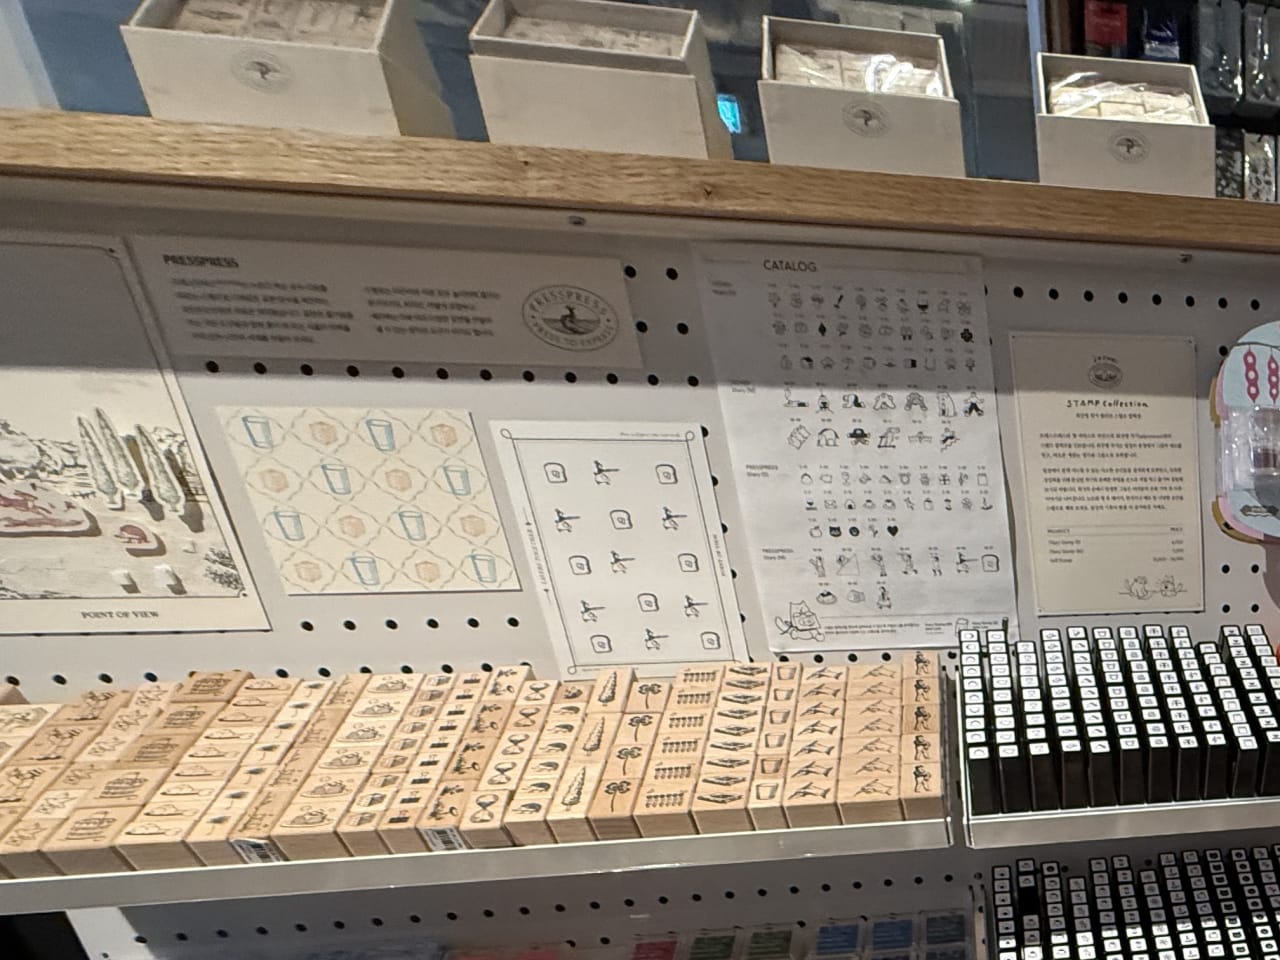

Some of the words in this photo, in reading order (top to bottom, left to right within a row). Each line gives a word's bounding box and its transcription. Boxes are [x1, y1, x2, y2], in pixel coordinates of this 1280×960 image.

[162, 254, 239, 268] PRESSPRESS
[763, 259, 817, 273] CATALOG
[1066, 399, 1100, 408] STAMP
[1102, 399, 1149, 408] Collection
[81, 611, 114, 619] POINT
[115, 611, 130, 619] OF
[132, 610, 159, 618] VIEW
